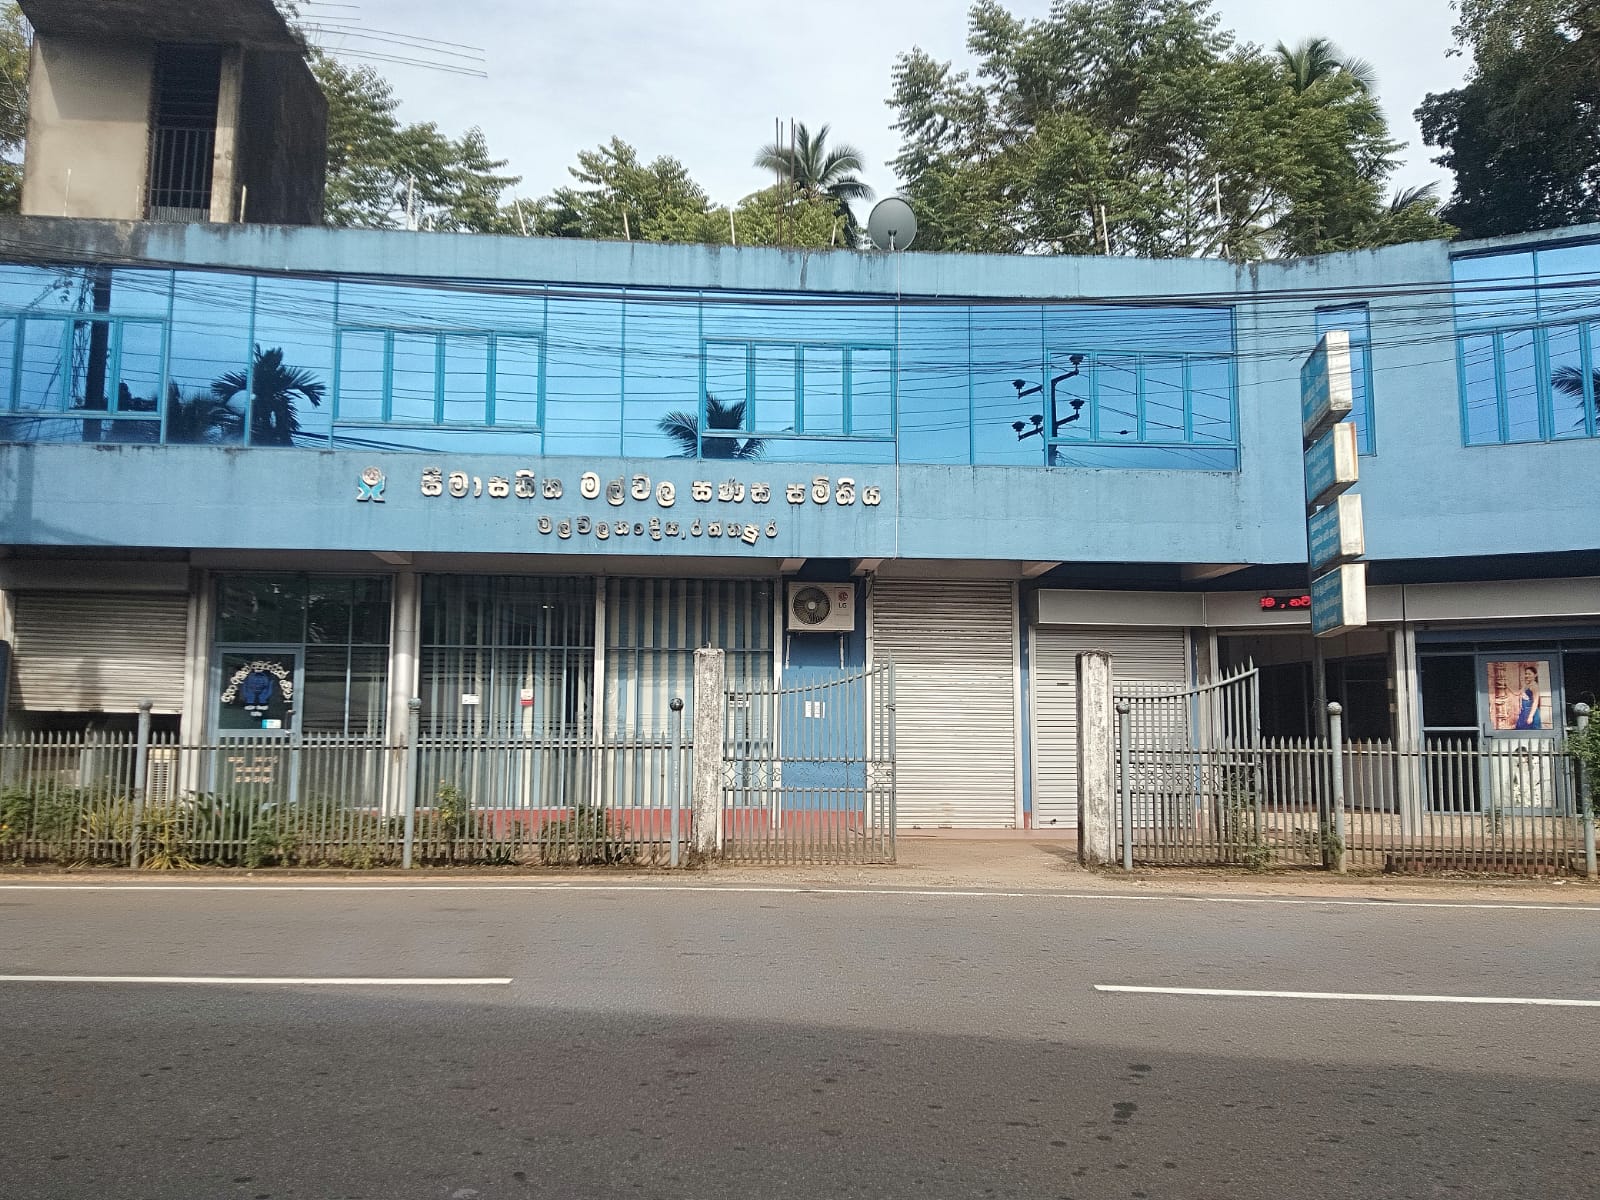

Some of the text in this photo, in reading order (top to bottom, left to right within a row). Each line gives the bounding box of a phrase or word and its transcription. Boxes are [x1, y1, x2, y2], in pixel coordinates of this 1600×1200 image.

[421, 466, 563, 499] සීමාසහිත
[580, 471, 676, 507] මල්වල
[786, 475, 881, 506] සමිතිය
